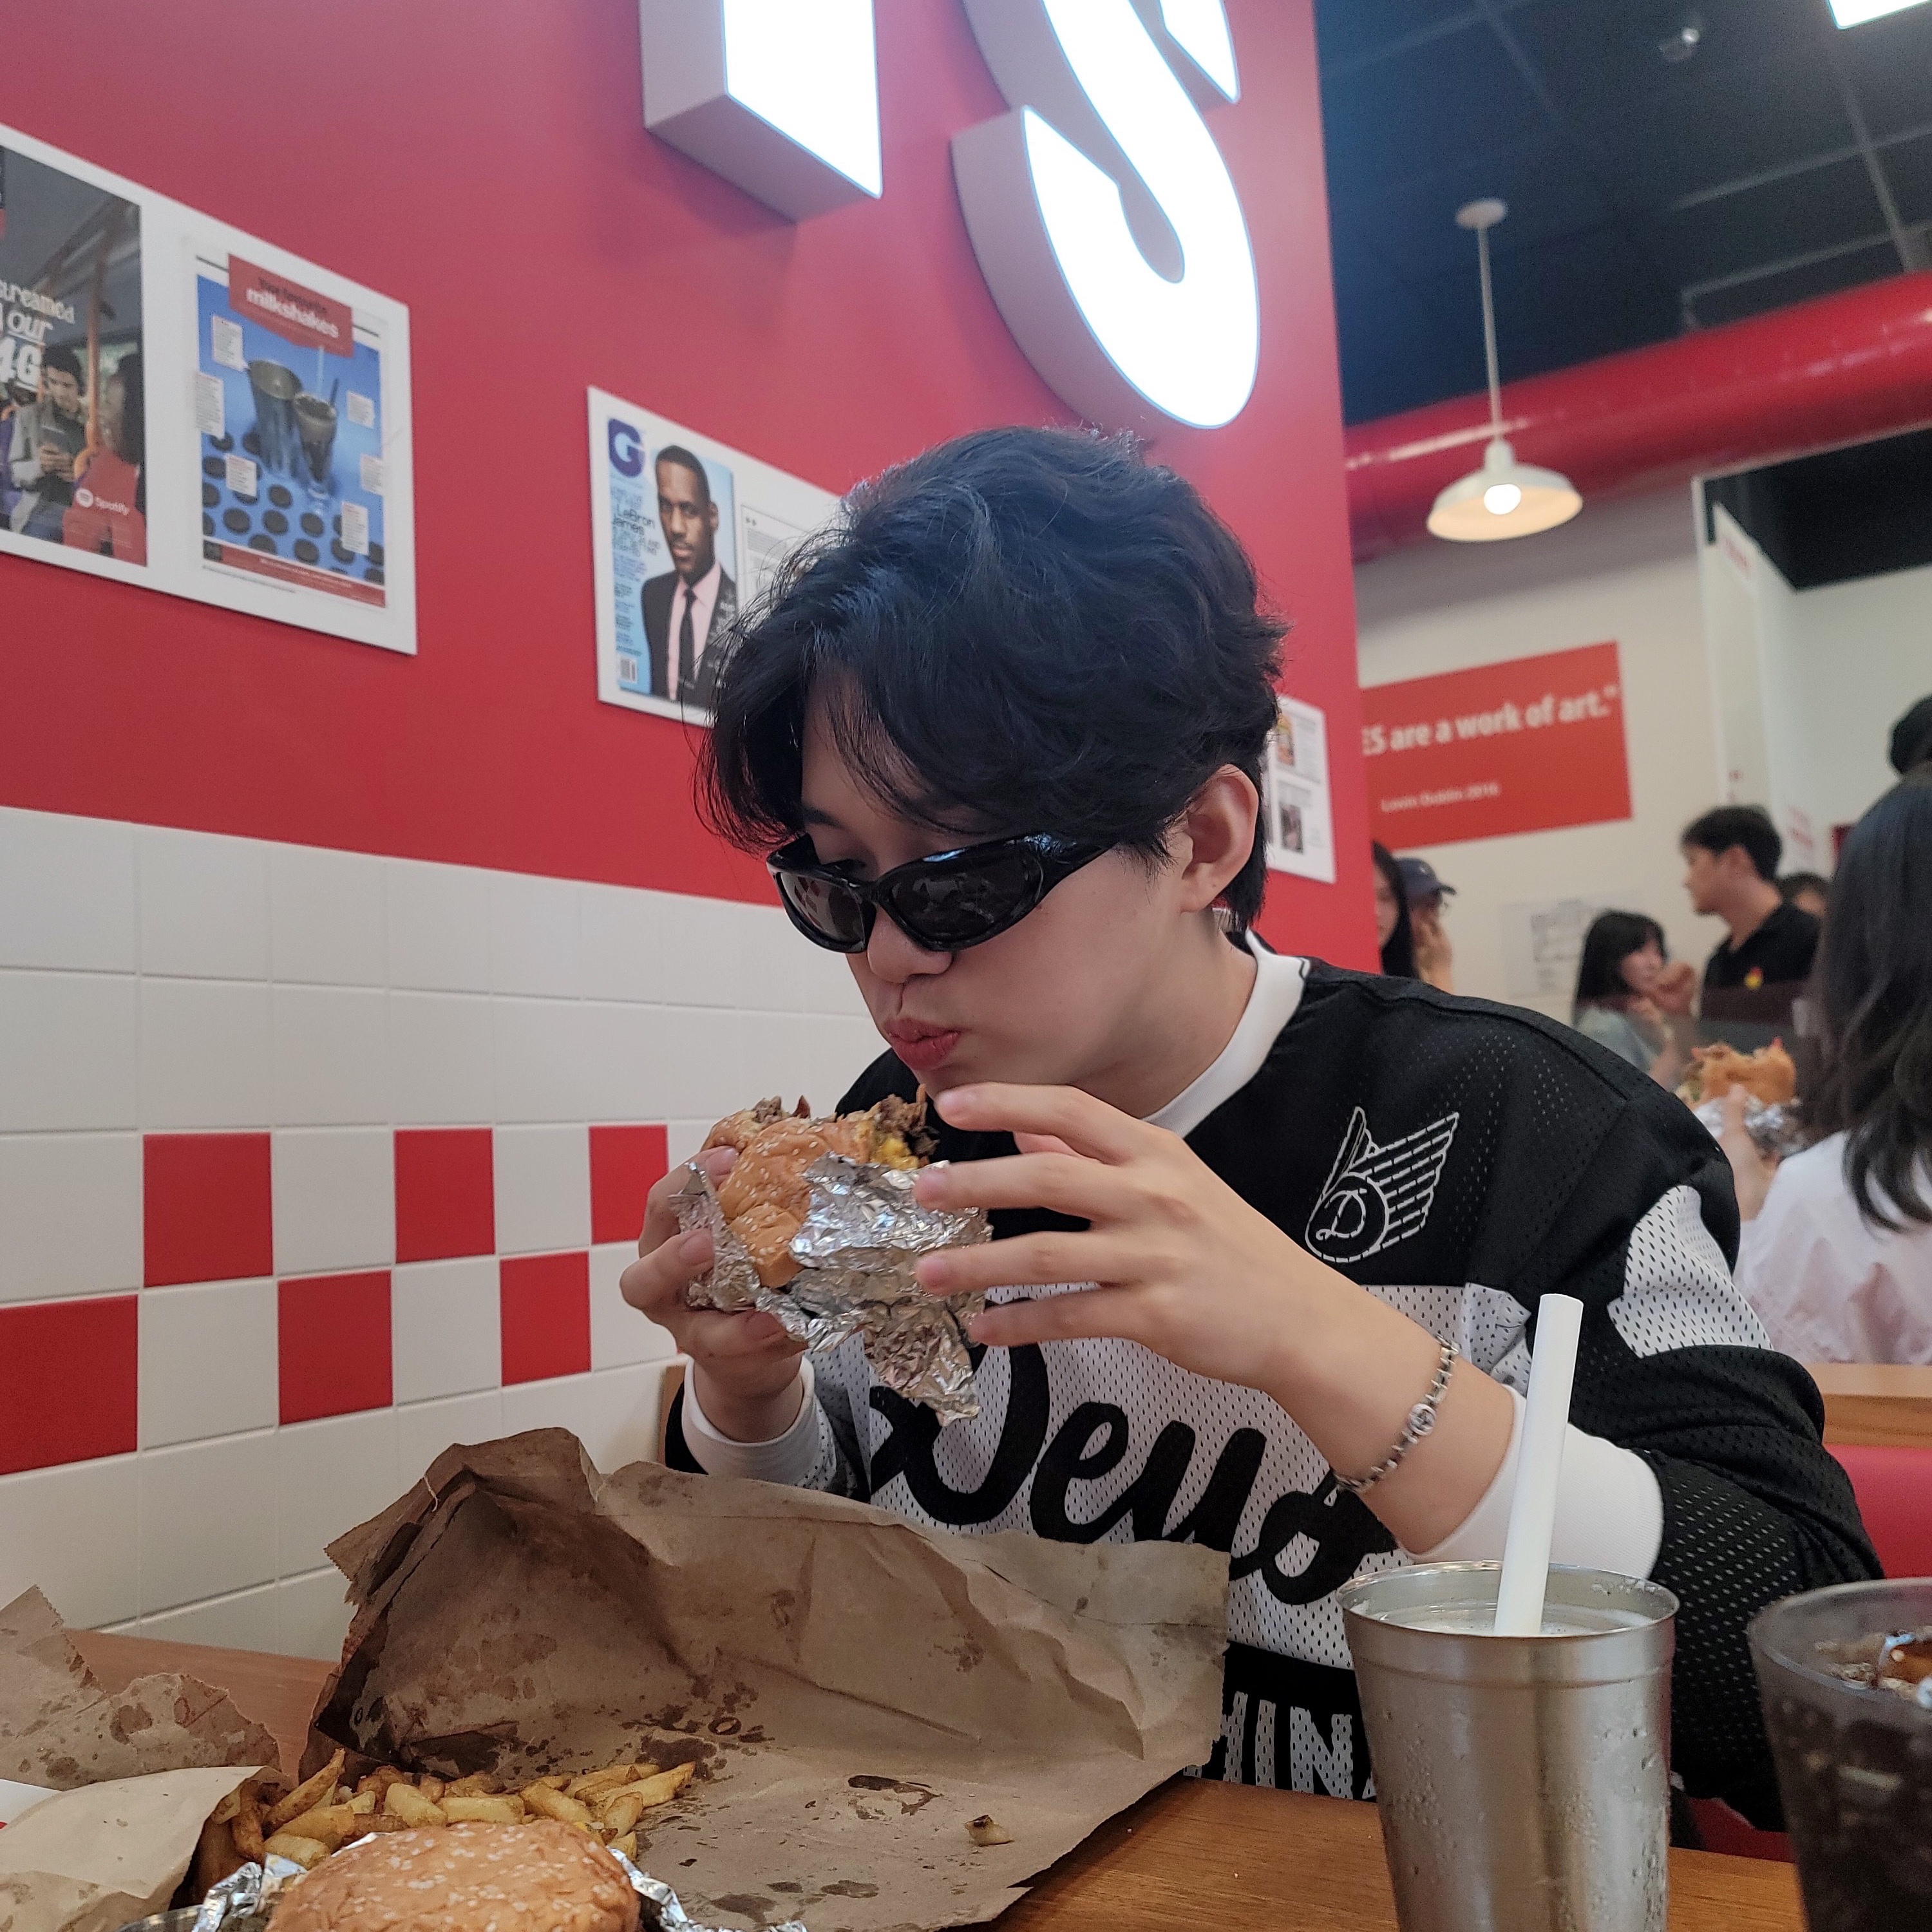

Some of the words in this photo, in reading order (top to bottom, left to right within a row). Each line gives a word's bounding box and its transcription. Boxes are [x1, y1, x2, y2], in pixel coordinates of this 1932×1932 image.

[7, 309, 53, 344] our
[246, 289, 339, 339] milkshakes
[1390, 724, 1432, 752] are
[1435, 720, 1453, 744] a
[1455, 702, 1521, 740] work
[1525, 693, 1555, 728] of
